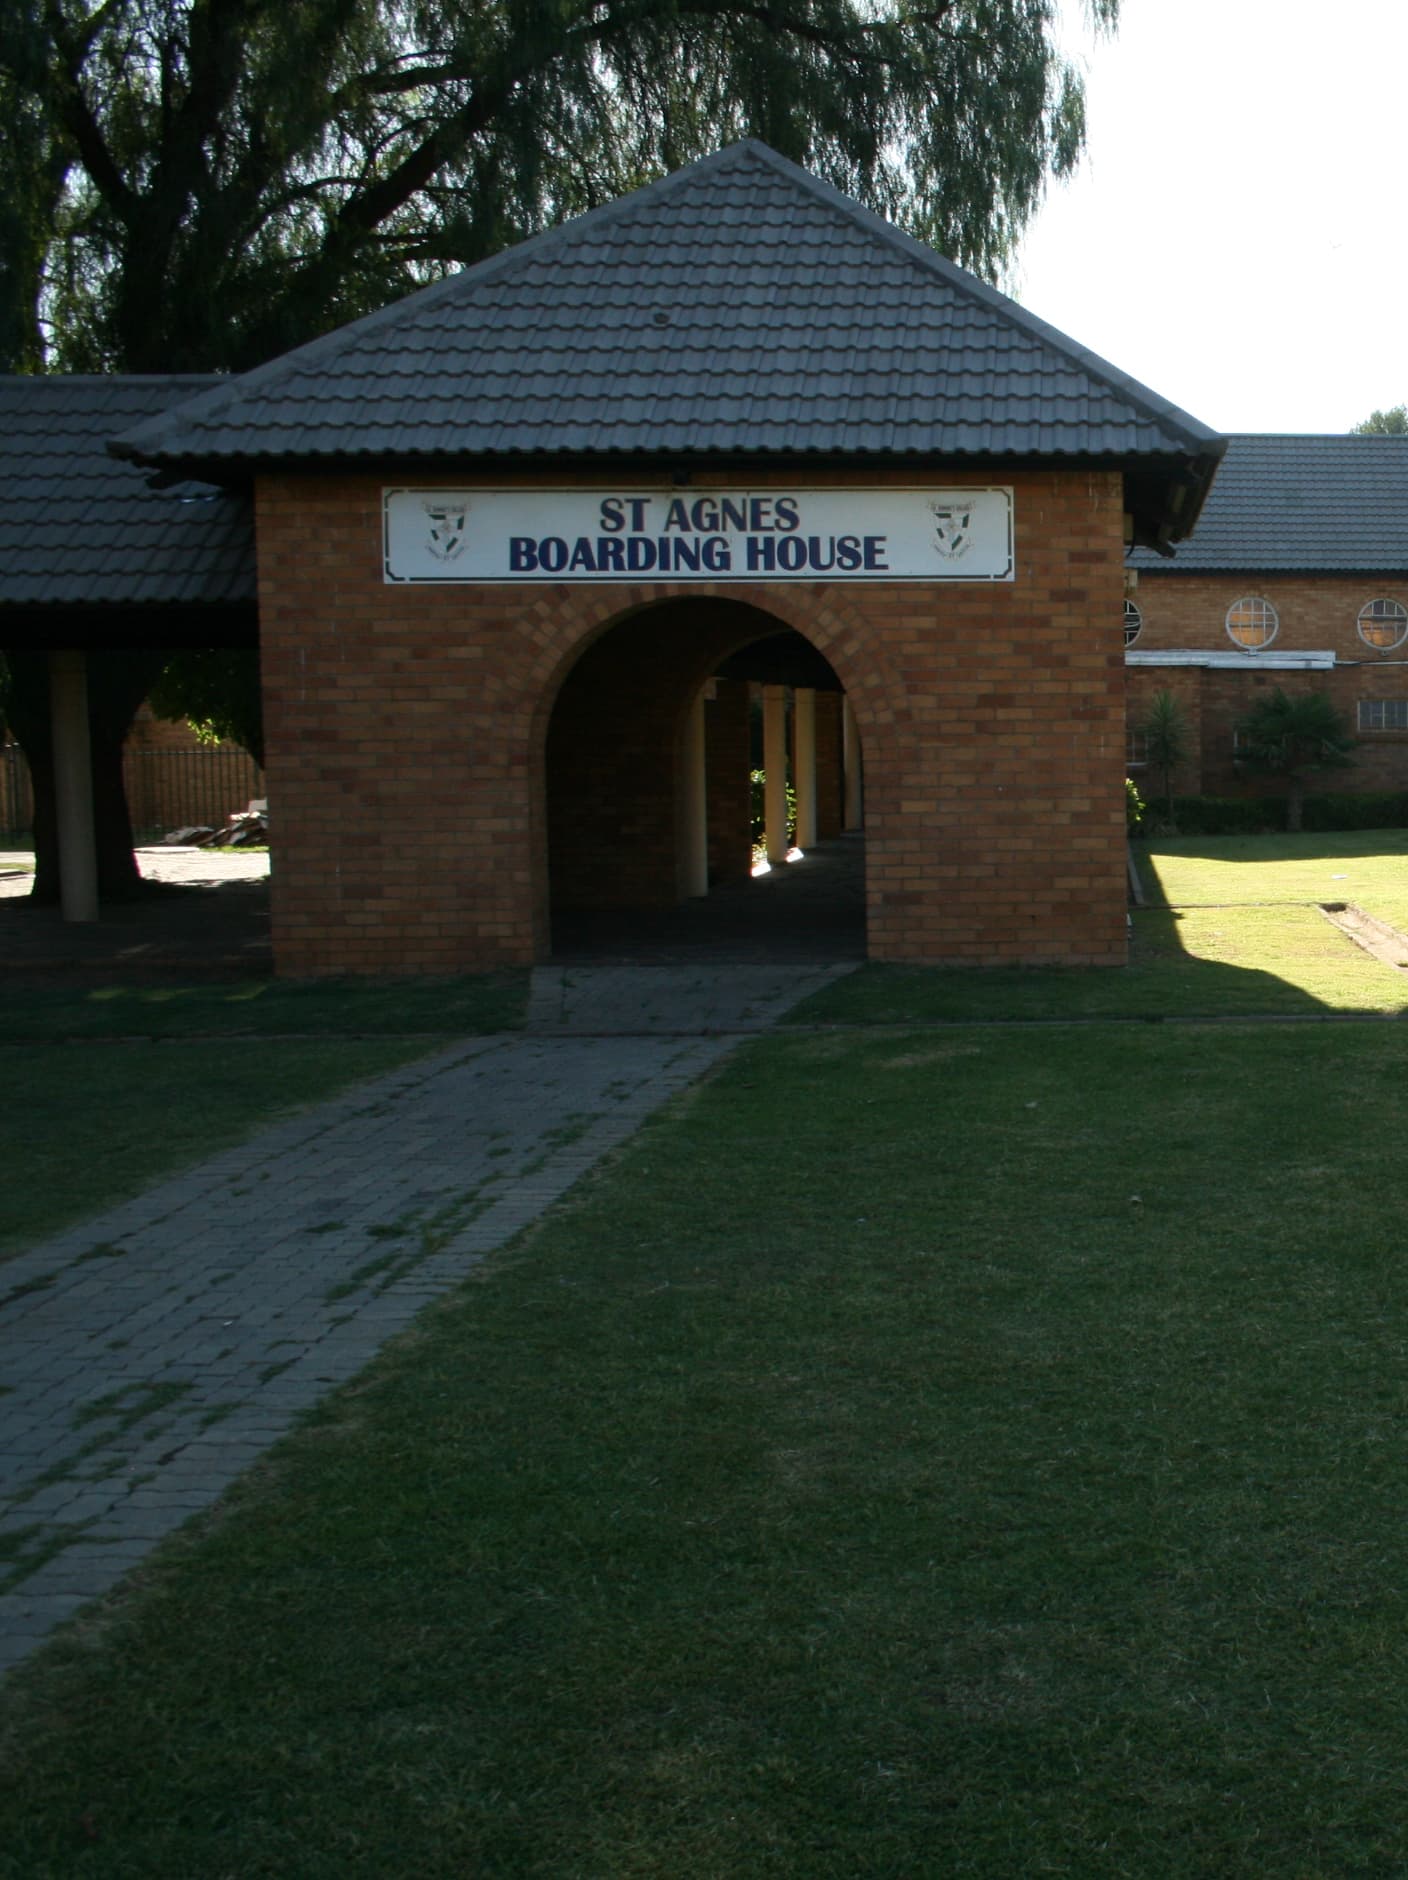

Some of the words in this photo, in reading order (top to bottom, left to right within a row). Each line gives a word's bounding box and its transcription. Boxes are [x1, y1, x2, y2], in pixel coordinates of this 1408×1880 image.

[600, 498, 652, 532] ST
[663, 497, 800, 532] AGNES
[509, 536, 731, 572] BOARDING
[746, 535, 889, 571] HOUSE
